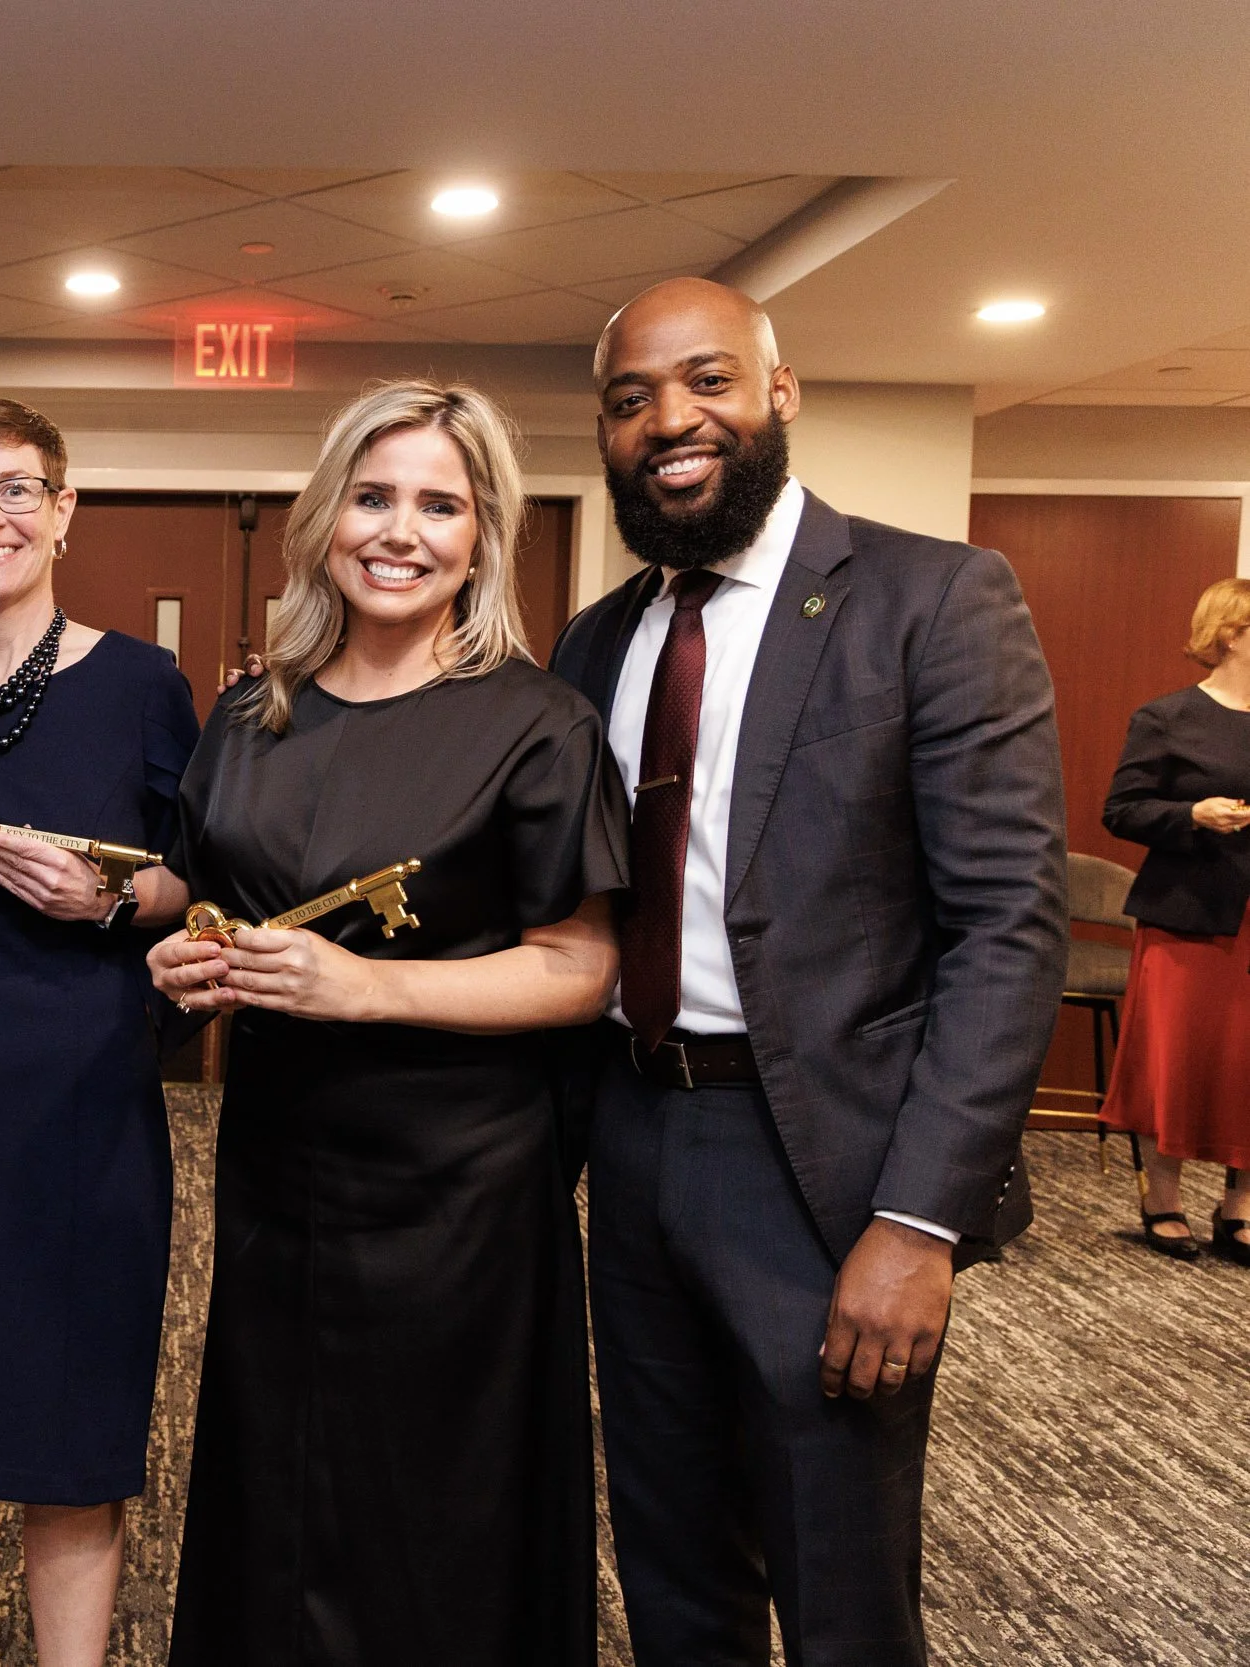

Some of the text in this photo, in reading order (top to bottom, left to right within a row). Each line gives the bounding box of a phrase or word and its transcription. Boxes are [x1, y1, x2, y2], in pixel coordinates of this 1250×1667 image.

[195, 323, 273, 377] EXIT
[41, 834, 58, 845] THE
[60, 838, 82, 848] CITY
[277, 894, 342, 926] KEY TO THE CITY
